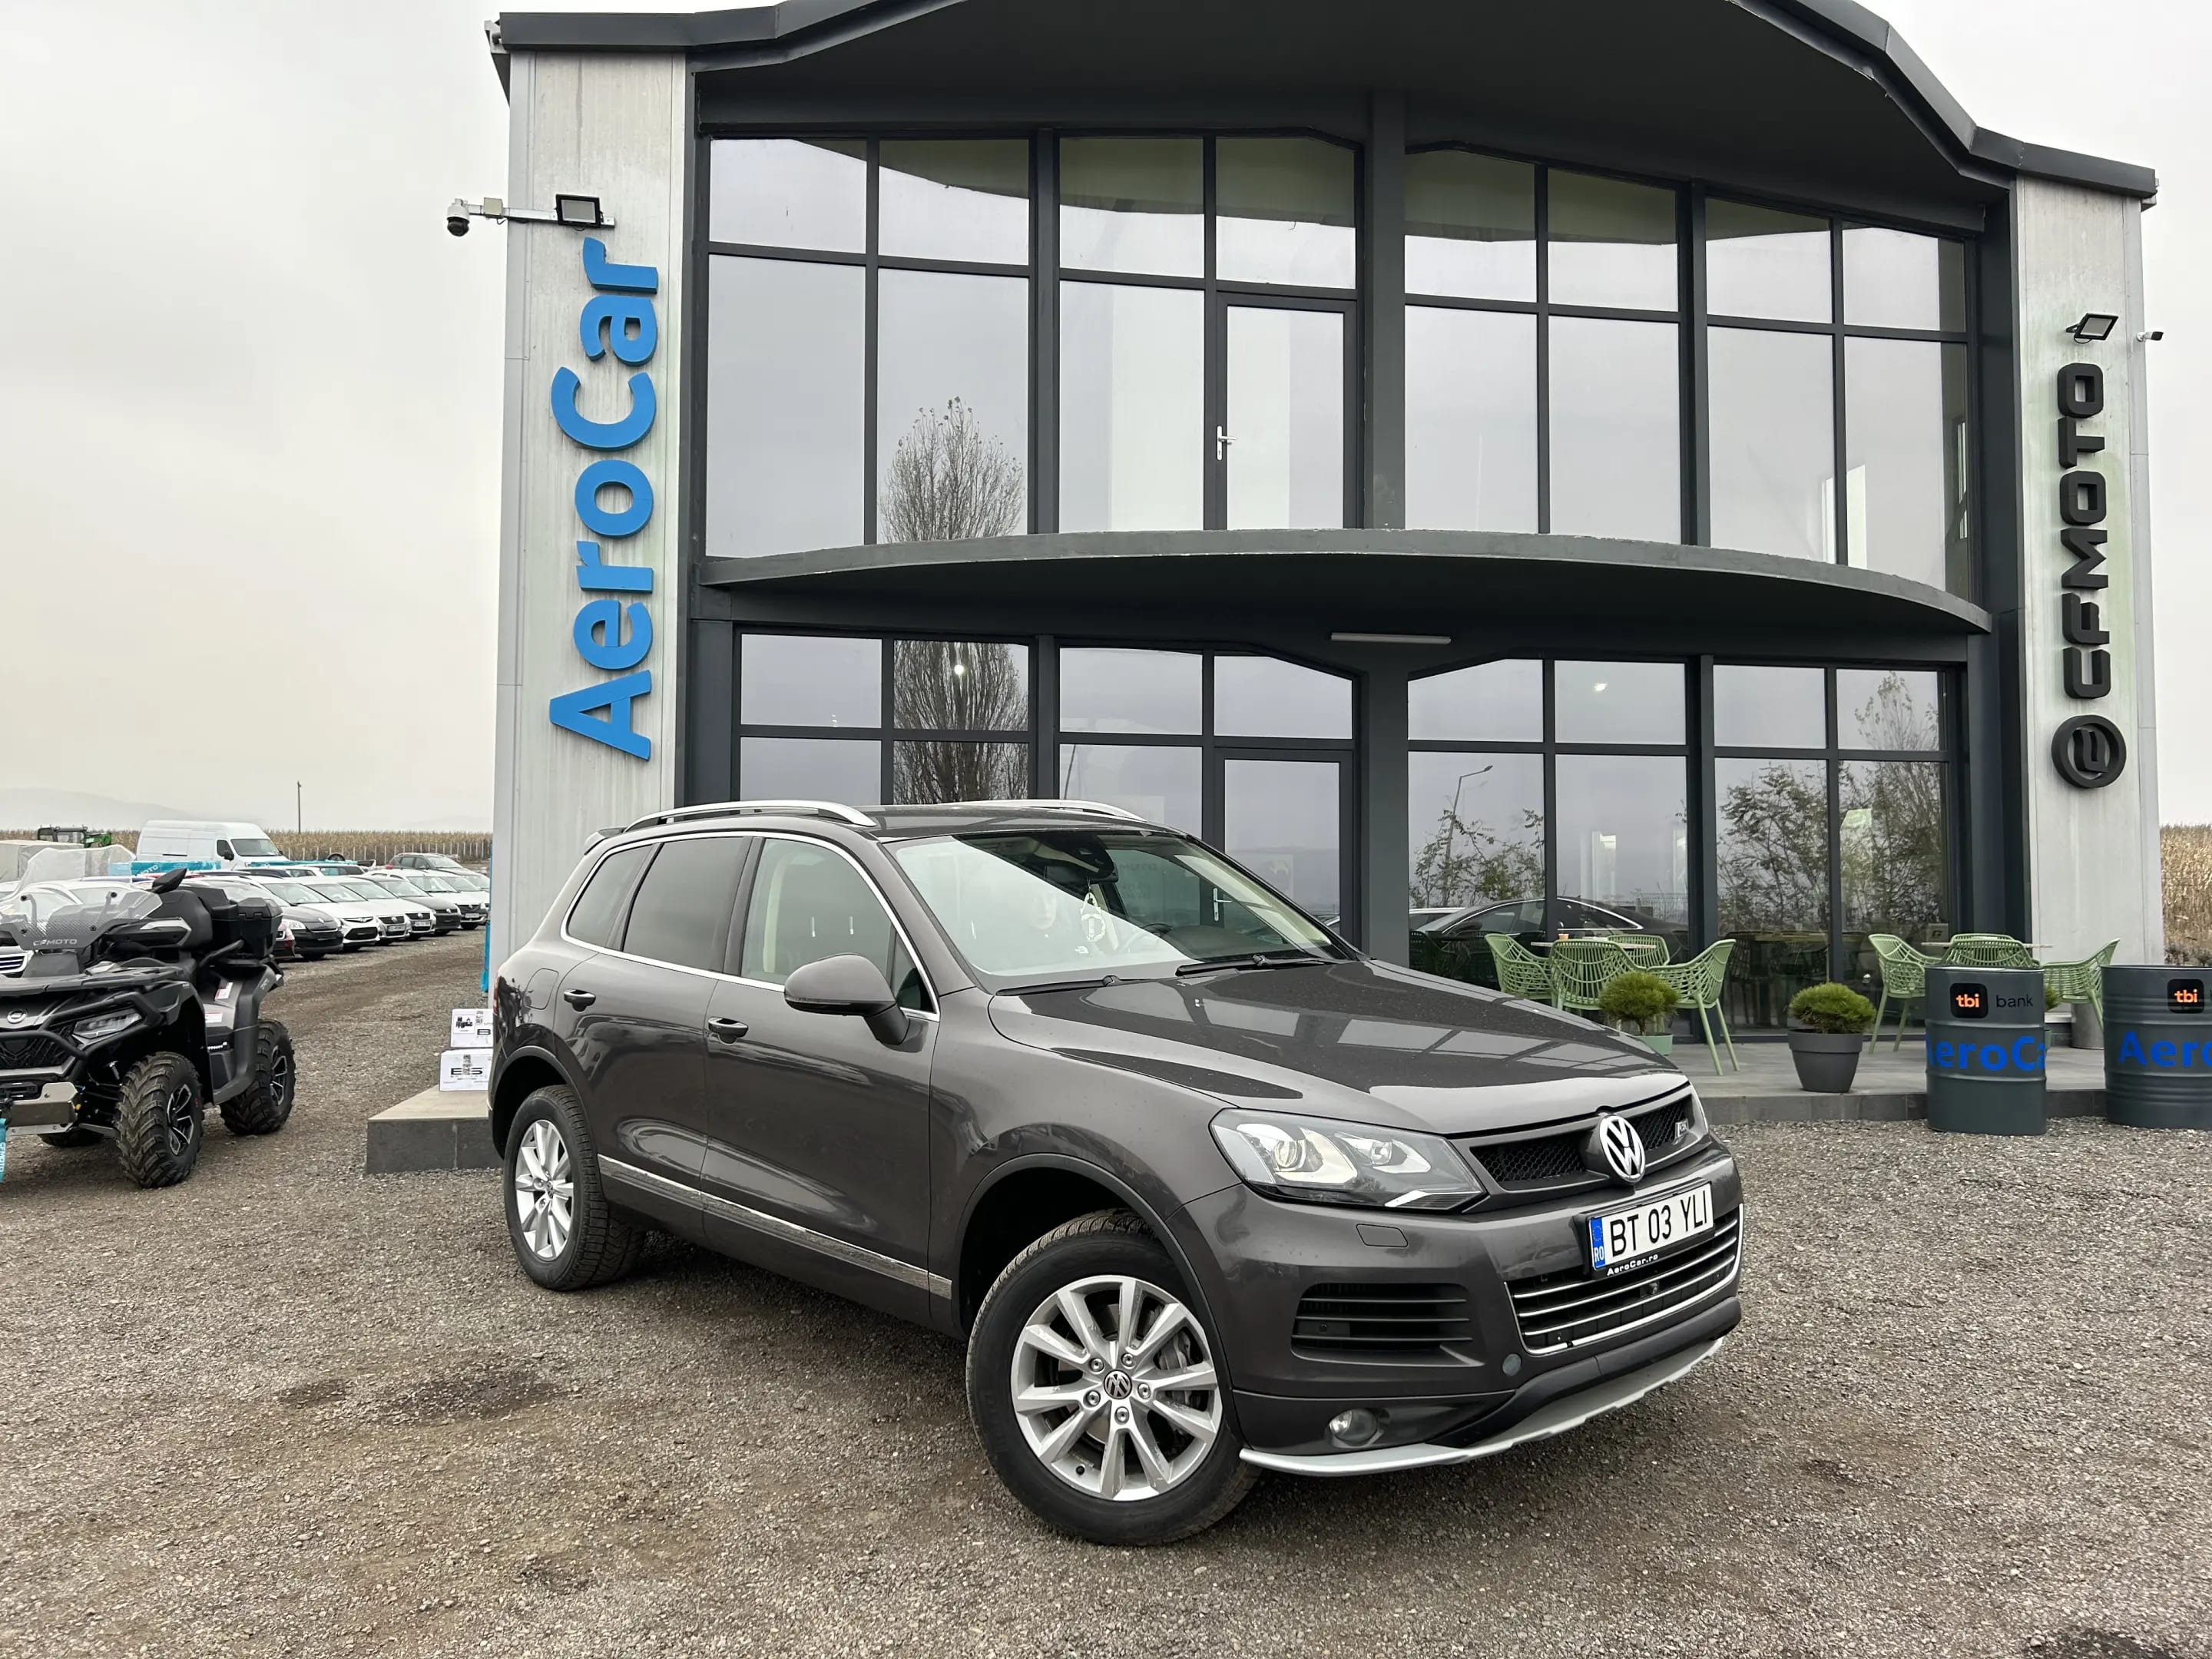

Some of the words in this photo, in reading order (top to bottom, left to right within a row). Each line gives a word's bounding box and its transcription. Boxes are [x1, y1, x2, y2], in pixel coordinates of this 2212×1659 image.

[549, 237, 659, 762] AeroCar
[2057, 363, 2111, 699] CFMOTO
[1955, 993, 1980, 1008] tbi
[1995, 994, 2034, 1008] bank
[2174, 988, 2198, 1003] tbi
[1610, 1214, 1639, 1257] BT
[1648, 1205, 1671, 1243] 03
[1681, 1190, 1707, 1232] YLI
[1594, 1246, 1604, 1262] RO
[1607, 1253, 1659, 1277] AeroCar.ro
